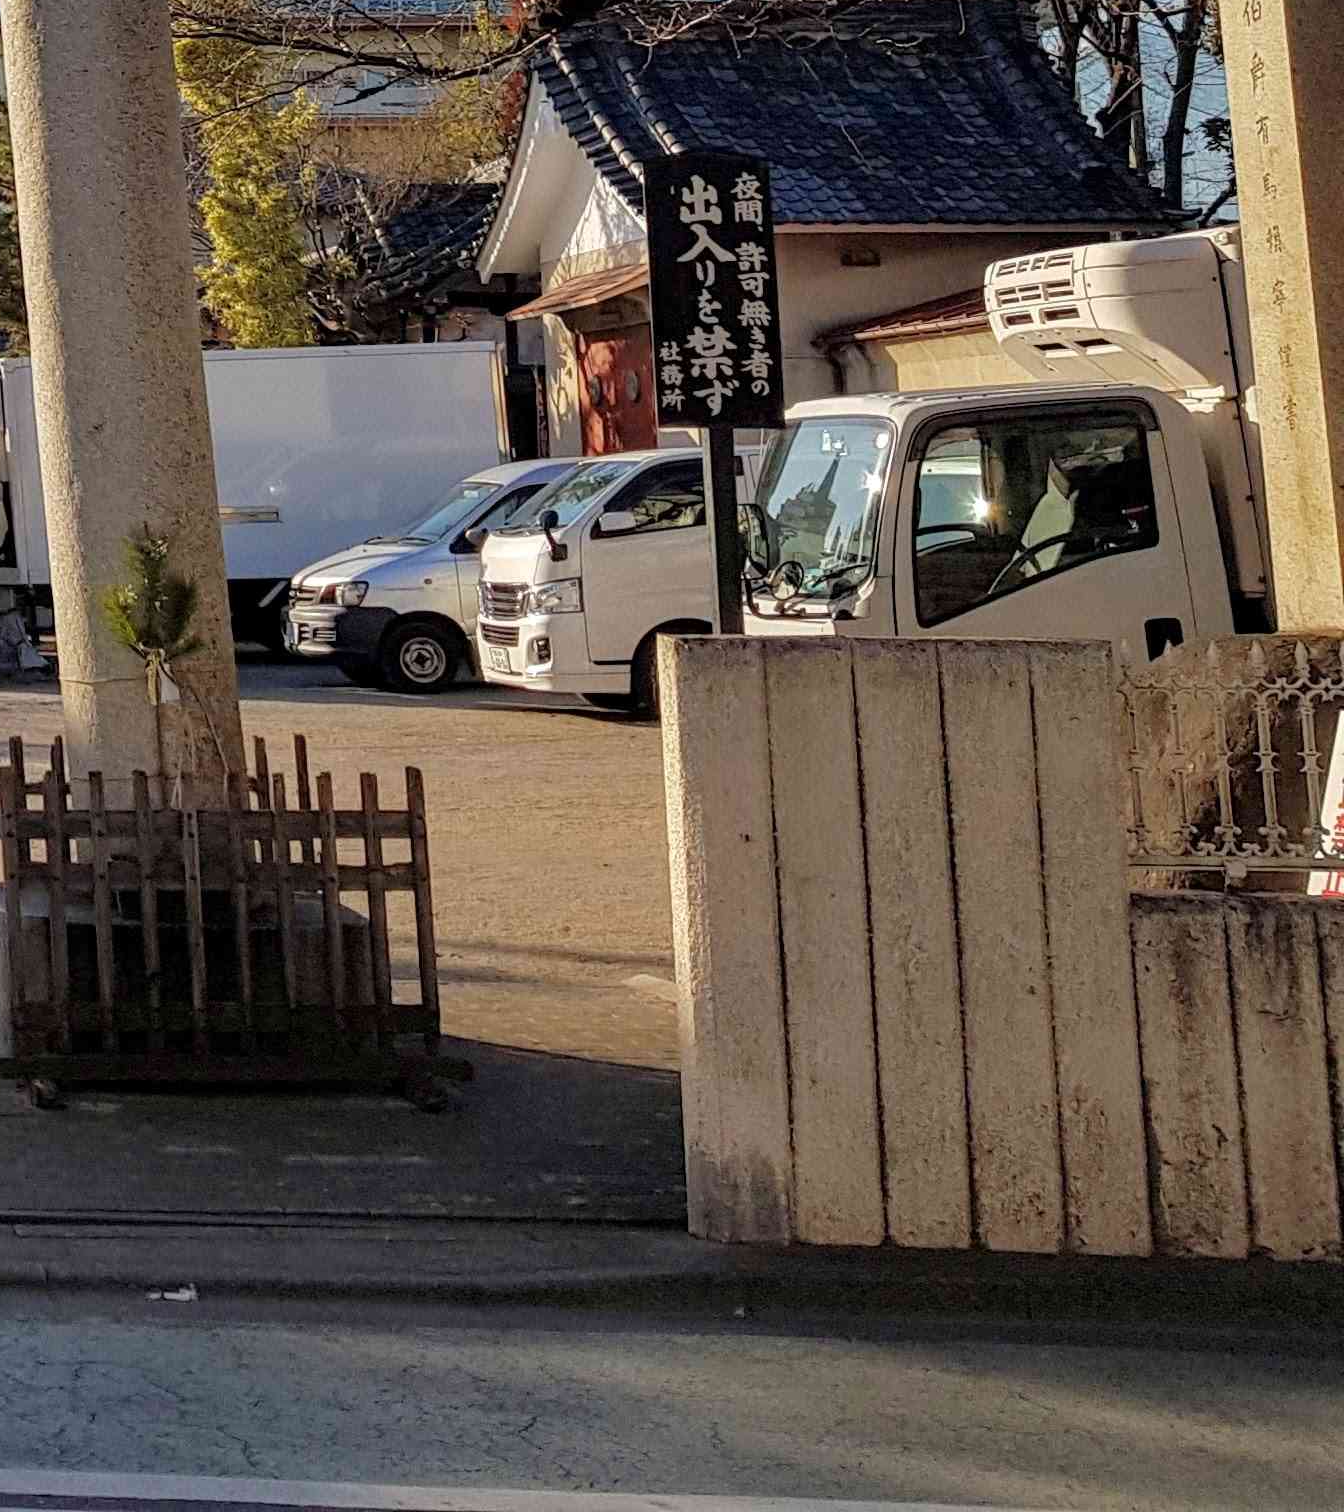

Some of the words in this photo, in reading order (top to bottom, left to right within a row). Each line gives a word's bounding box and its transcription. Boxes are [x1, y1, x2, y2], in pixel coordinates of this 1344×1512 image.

[676, 174, 740, 417] 出入りを禁ず
[659, 340, 686, 412] 社務所
